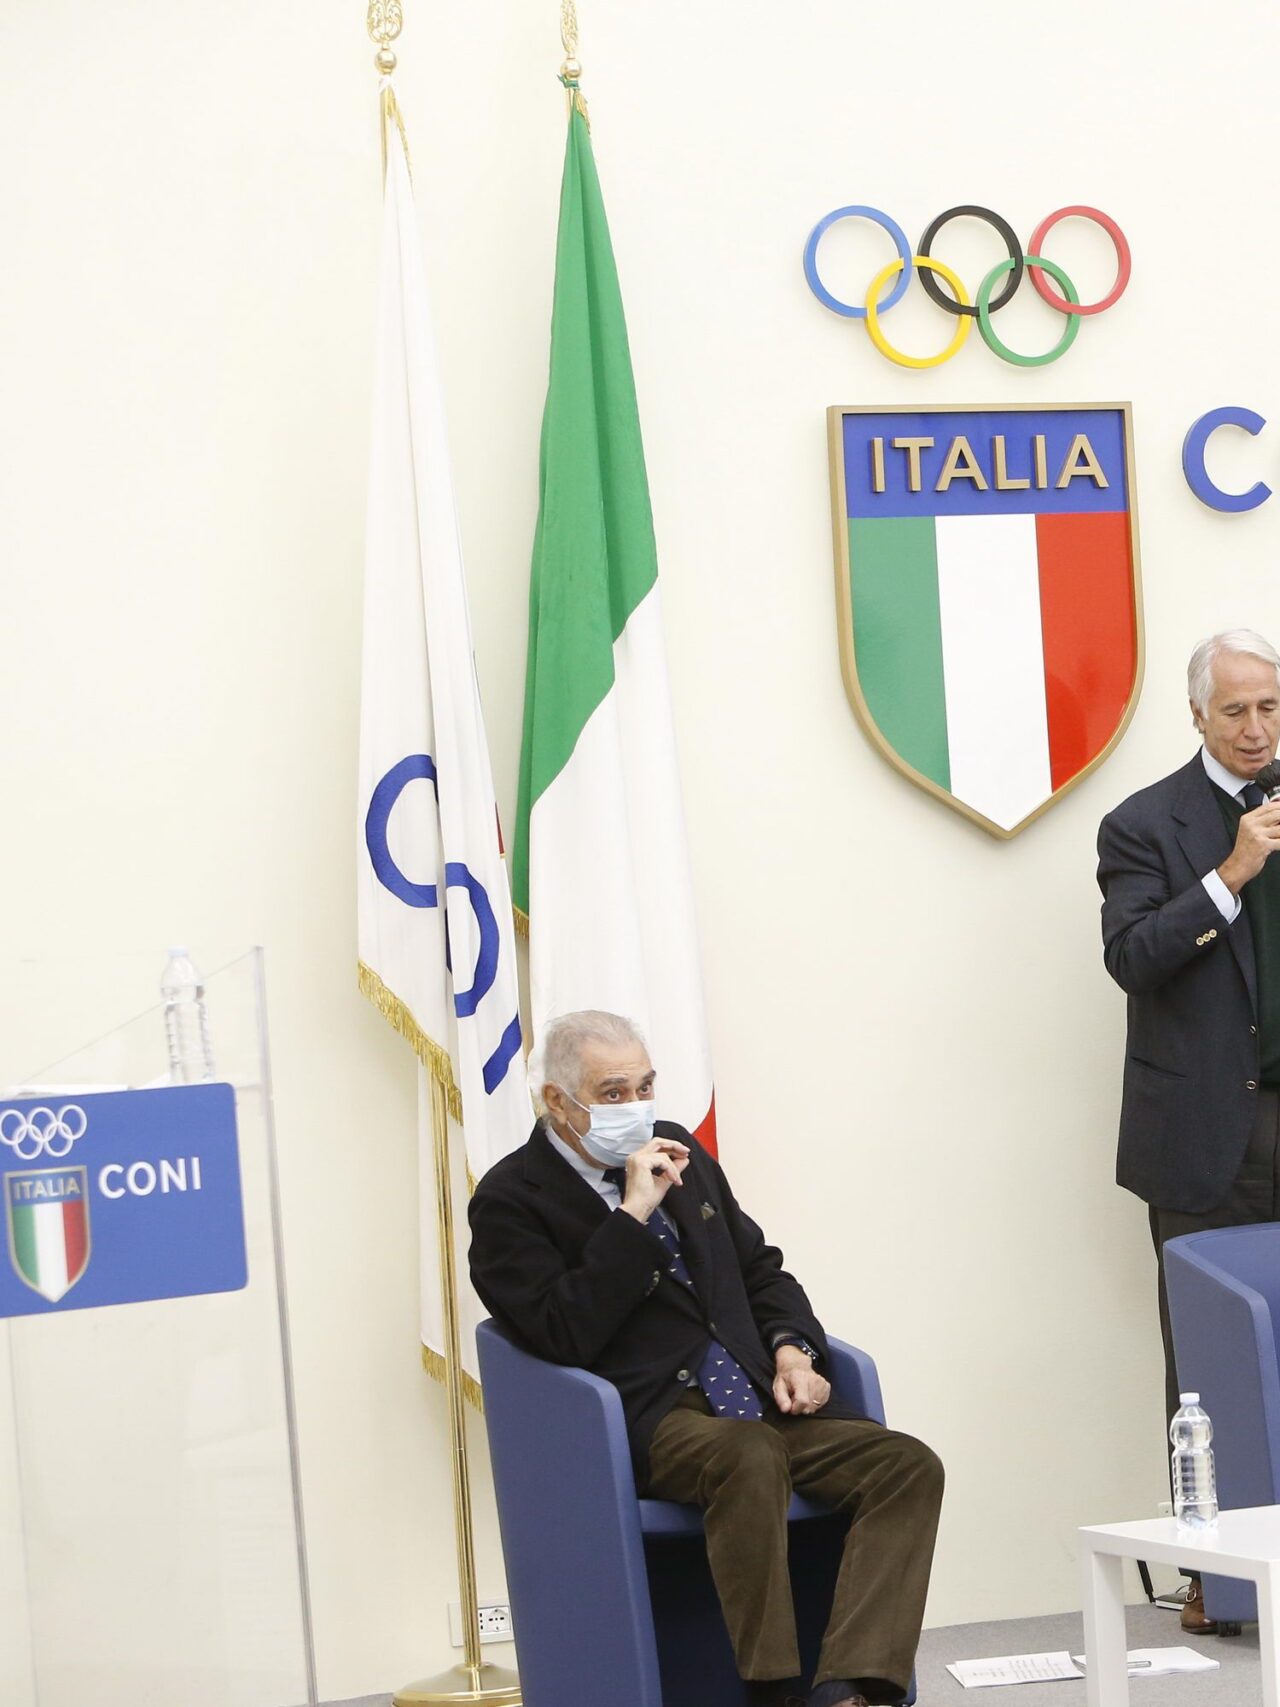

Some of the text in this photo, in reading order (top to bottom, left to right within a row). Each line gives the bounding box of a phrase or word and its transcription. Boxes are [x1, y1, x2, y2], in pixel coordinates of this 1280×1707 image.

[870, 434, 1109, 493] ITALIA
[14, 1177, 82, 1200] ITALIA
[98, 1156, 202, 1199] CONI
